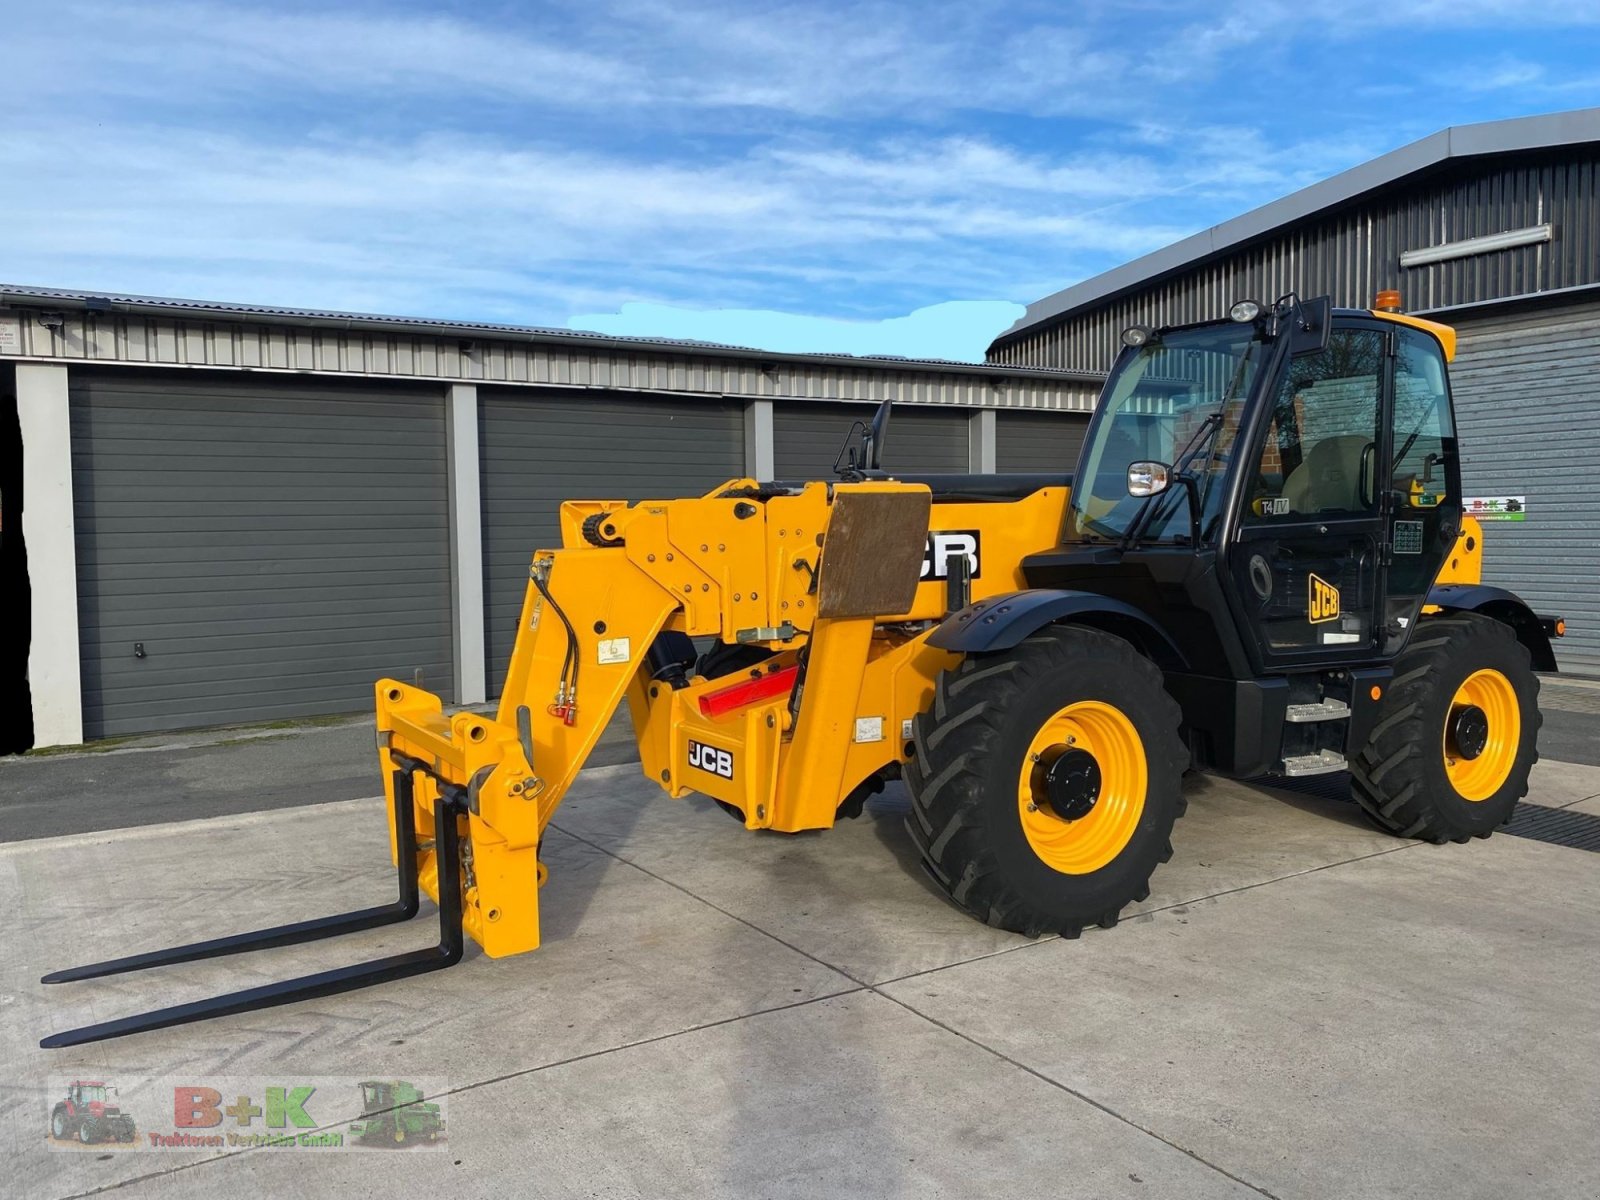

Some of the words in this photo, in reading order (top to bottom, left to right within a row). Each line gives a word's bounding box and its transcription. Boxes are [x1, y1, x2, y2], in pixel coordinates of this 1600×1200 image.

[1473, 500, 1499, 509] B+K
[1311, 580, 1338, 619] JCB
[689, 743, 732, 777] JCB
